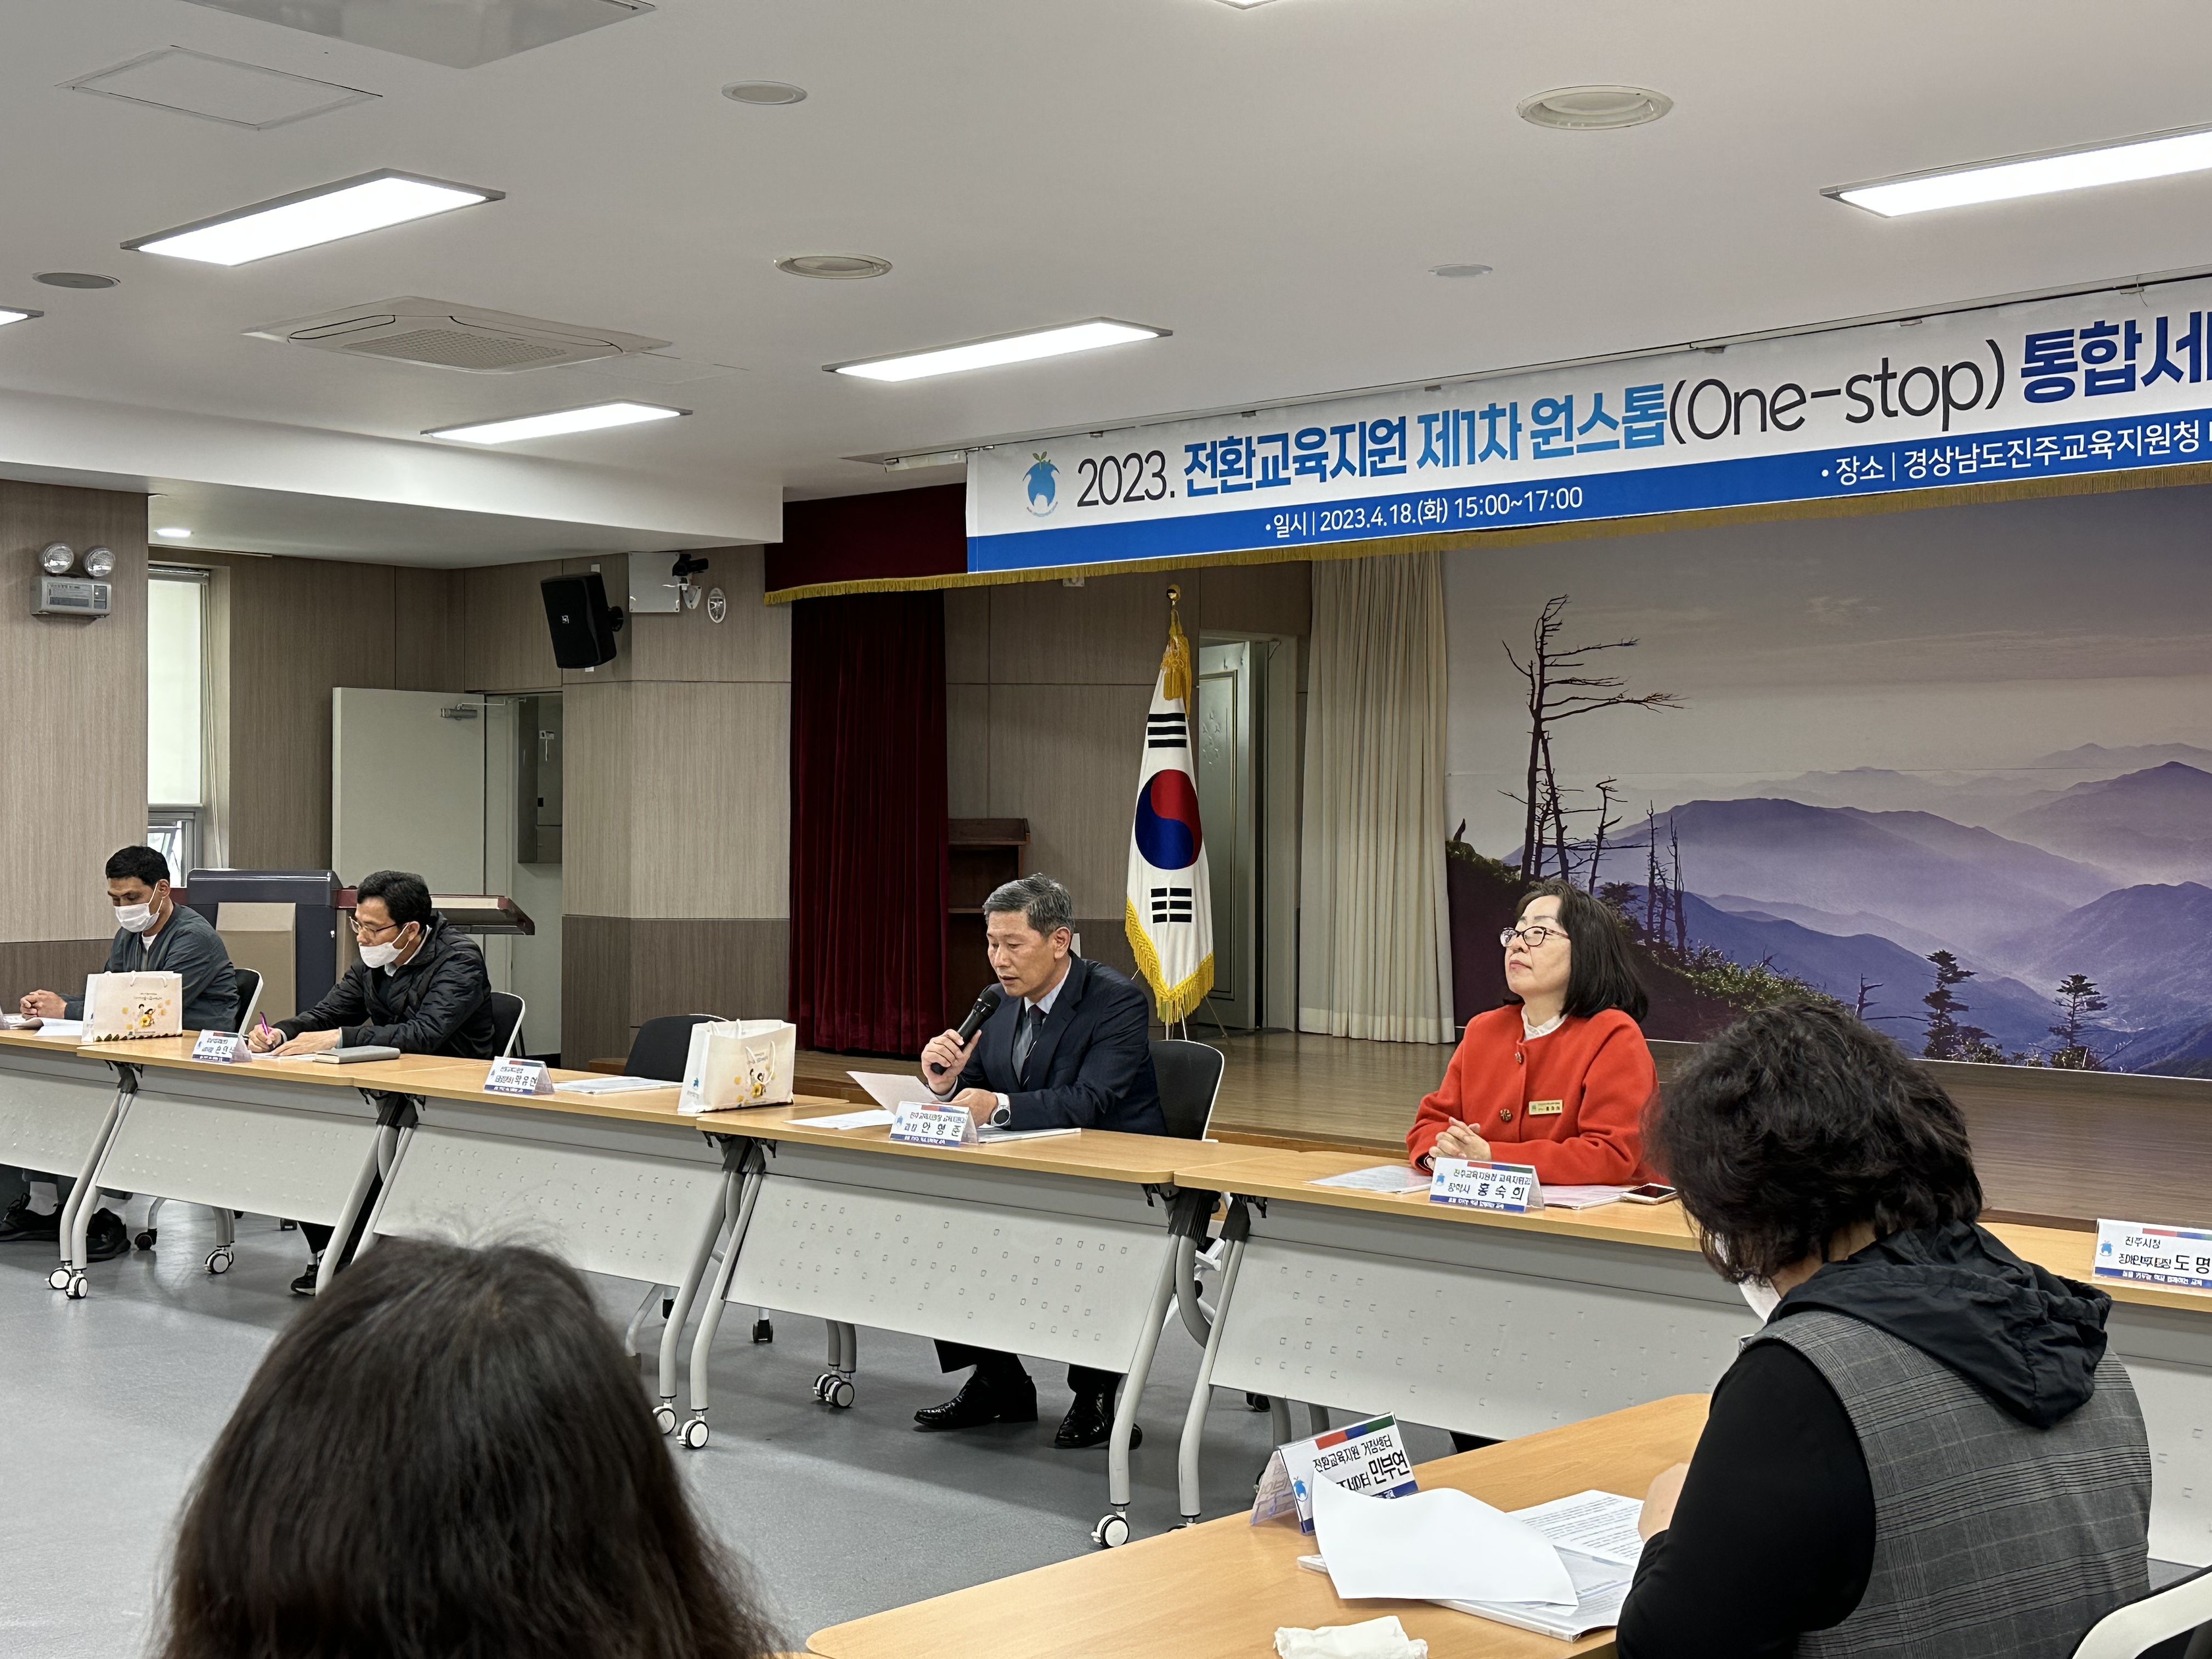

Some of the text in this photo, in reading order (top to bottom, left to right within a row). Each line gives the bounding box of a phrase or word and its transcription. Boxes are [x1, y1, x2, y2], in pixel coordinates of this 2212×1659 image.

[1077, 450, 1175, 507] 2023.
[1184, 415, 1407, 498] 전환교육지원
[1417, 402, 1522, 469] 제1차
[1904, 424, 2199, 479] 경상남도진주교육지원청
[1320, 498, 1448, 531] 2023.4.18.(화)
[1454, 487, 1582, 518] 15:00~17:00
